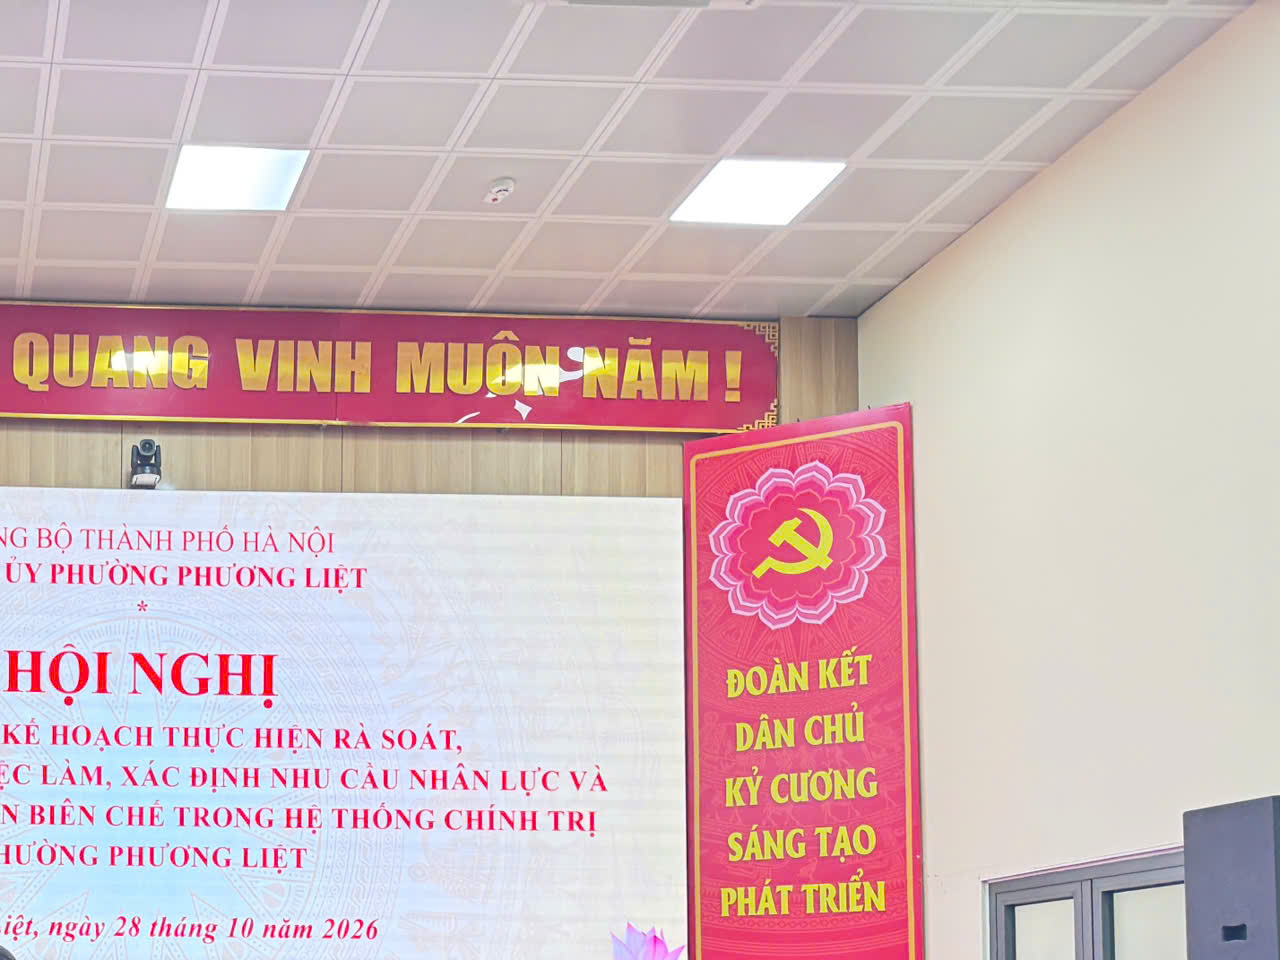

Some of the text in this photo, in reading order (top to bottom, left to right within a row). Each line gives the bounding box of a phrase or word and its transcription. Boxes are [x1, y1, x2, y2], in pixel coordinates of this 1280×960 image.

[11, 333, 209, 394] QUANG
[235, 338, 371, 393] VINH
[396, 329, 559, 397] MUÔN
[582, 337, 708, 401] NĂM
[723, 350, 742, 402] !
[37, 522, 73, 553] BỘ
[80, 522, 172, 551] THÀNH
[182, 523, 234, 552] PHỐ
[243, 524, 278, 553] HÀ
[287, 525, 335, 557] NỘI
[5, 556, 43, 583] ỦY
[50, 559, 169, 586] PHƯỜNG
[178, 562, 296, 588] PHƯƠNG
[304, 563, 368, 594] LIỆT
[3, 643, 276, 708] HỘI NGHỊ
[728, 648, 872, 697] ĐOÀN KẾT
[2, 718, 40, 746] KẾ
[52, 726, 152, 751] HOẠCH
[163, 725, 244, 754] THỰC
[256, 728, 321, 754] HIỆN
[336, 723, 371, 749] RÀ
[382, 725, 462, 752] SOÁT,
[736, 703, 864, 751] DÂN CHỦ
[41, 758, 111, 788] LÀM,
[121, 759, 180, 787] XÁC
[189, 766, 261, 794] ĐỊNH
[270, 767, 331, 789] NHU
[340, 761, 400, 791] CẦU
[410, 763, 488, 790] NHÂN
[499, 769, 560, 797] LỰC
[570, 766, 606, 791] VÀ
[726, 768, 877, 806] KỶ CƯƠNG
[31, 799, 94, 824] BIÊN
[105, 799, 165, 828] CHẾ
[173, 805, 274, 829] TRONG
[284, 803, 323, 834] HỆ
[331, 800, 436, 831] THỐNG
[443, 804, 538, 832] CHÍNH
[548, 811, 595, 837] TRỊ
[108, 842, 232, 869] PHƯƠNG
[241, 844, 308, 874] LIỆT
[728, 824, 876, 862] SÁNG TẠO
[721, 870, 885, 916] PHÁT TRIỂN
[49, 915, 105, 944] ngày
[115, 916, 140, 936] 28
[149, 916, 218, 945] tháng
[229, 919, 254, 937] 10
[262, 917, 314, 940] năm
[323, 919, 377, 940] 2026
